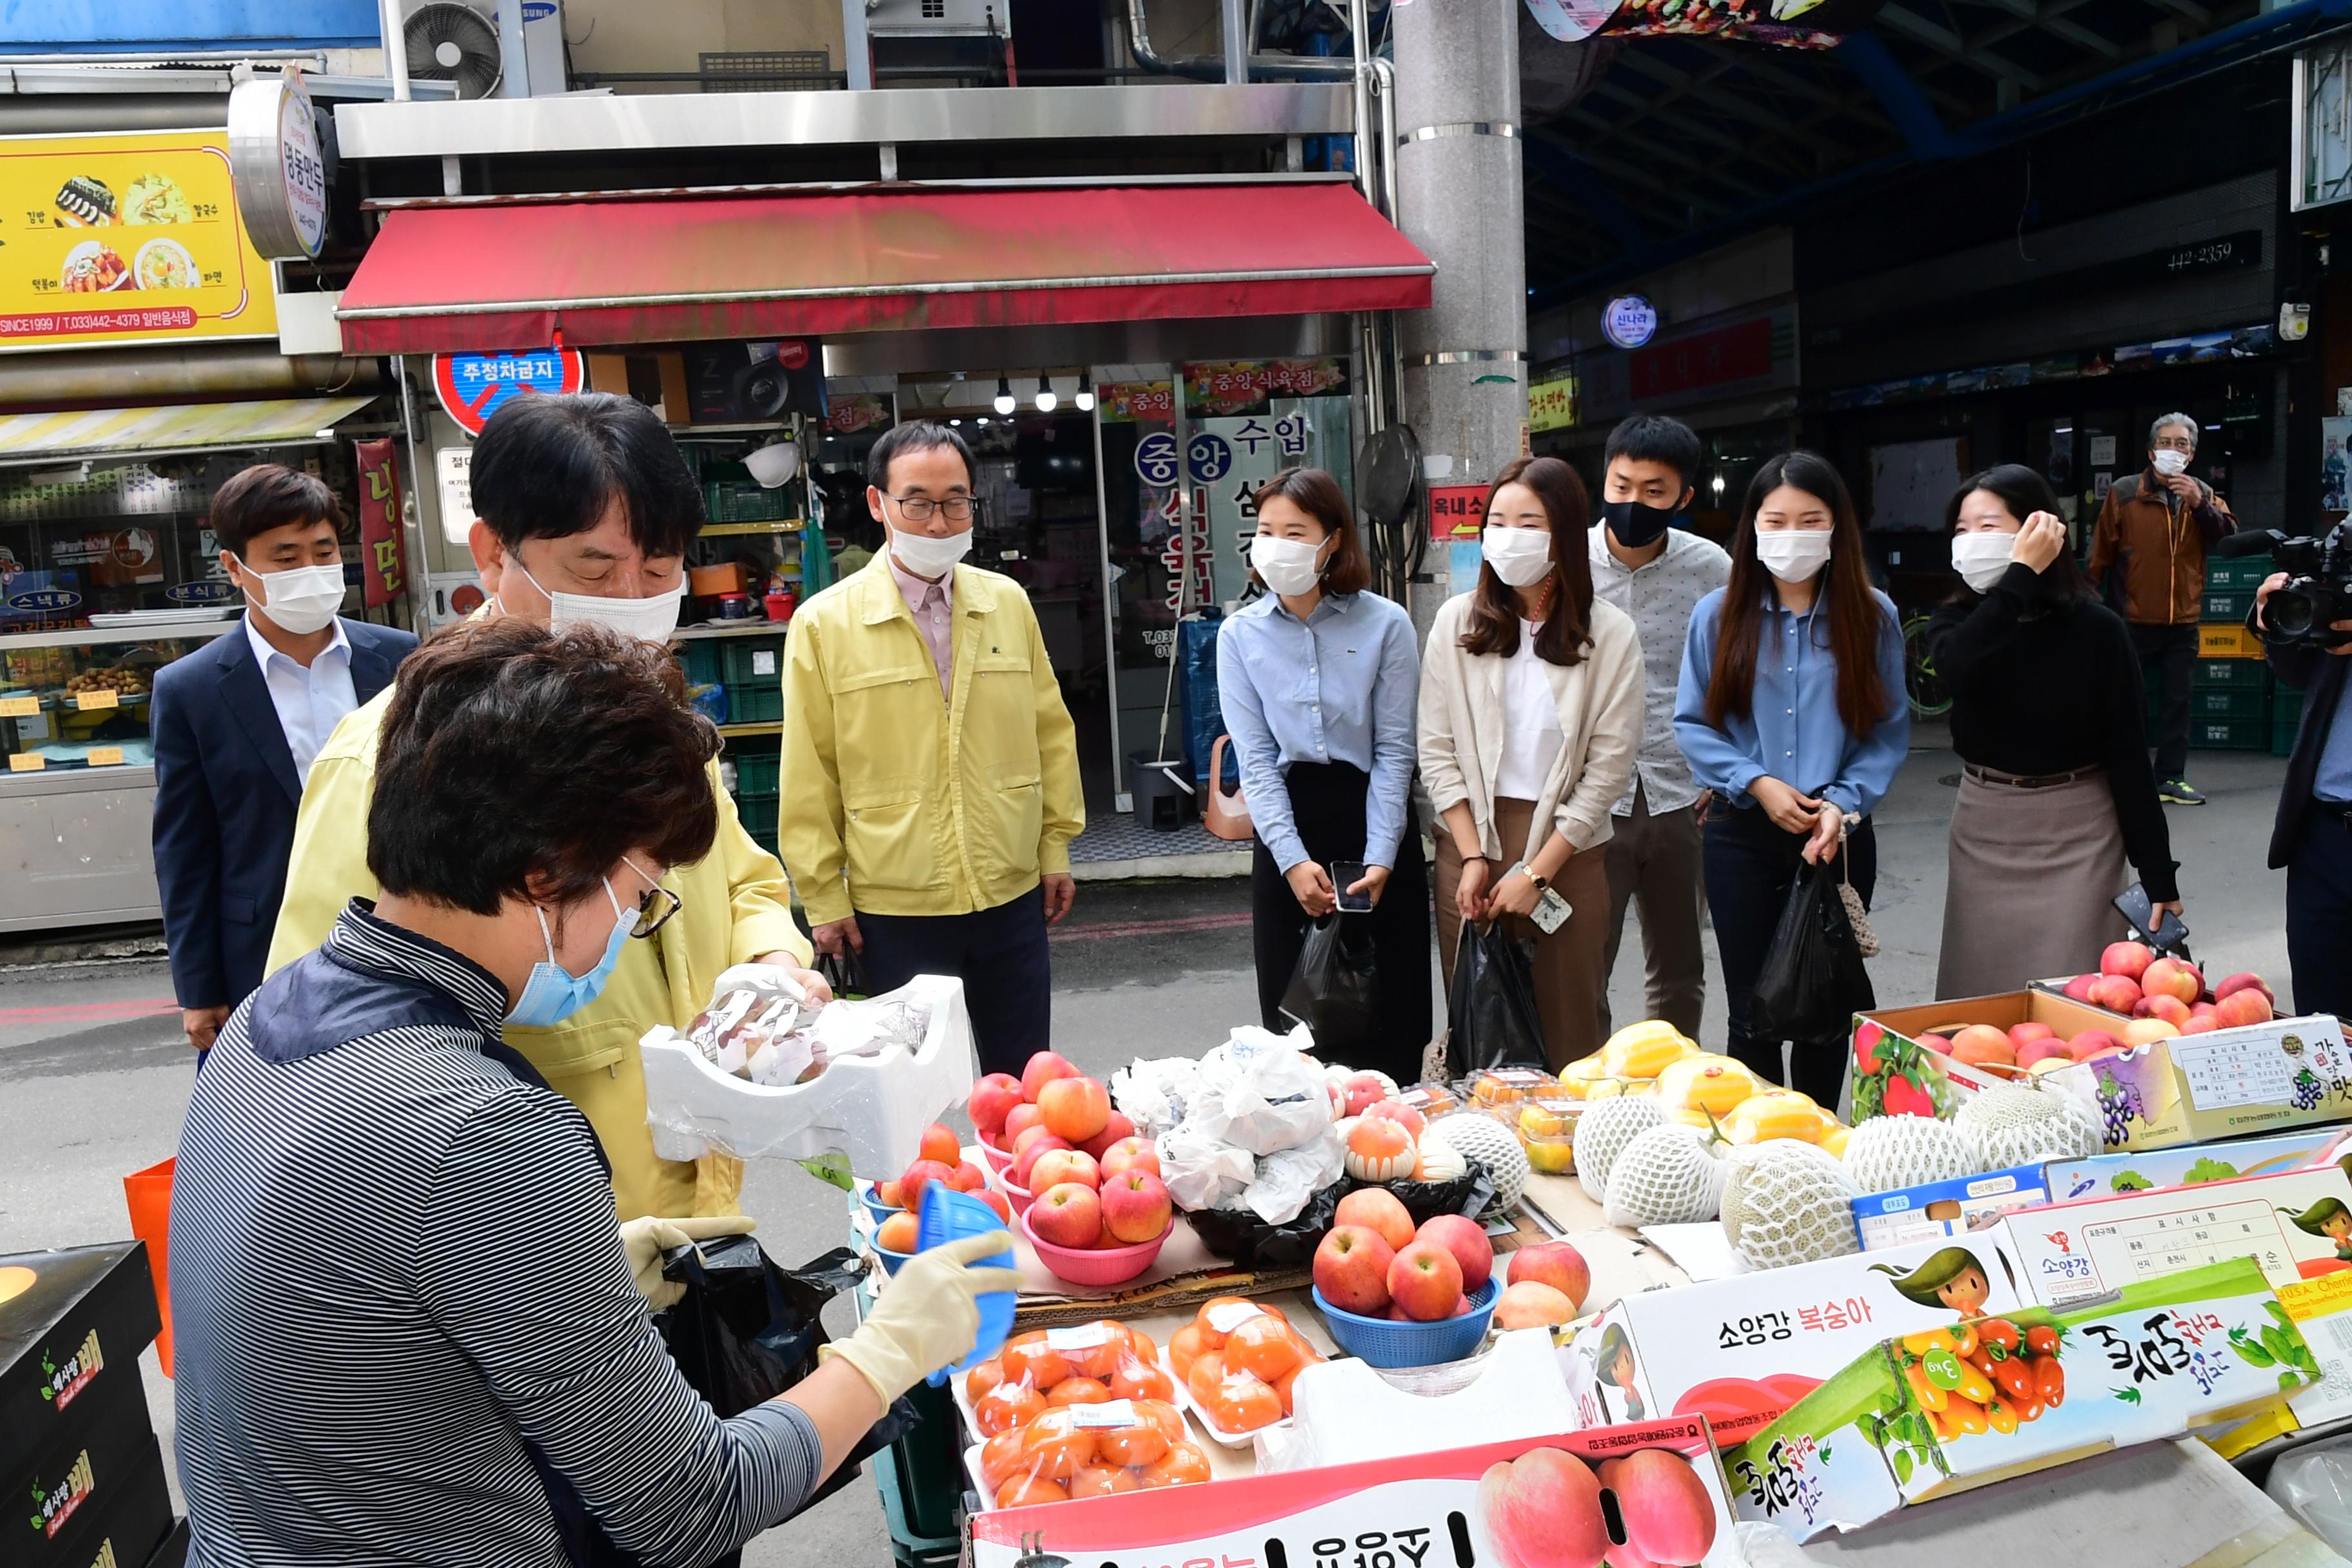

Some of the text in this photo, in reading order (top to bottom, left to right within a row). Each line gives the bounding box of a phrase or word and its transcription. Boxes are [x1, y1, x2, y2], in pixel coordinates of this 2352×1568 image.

[284, 141, 322, 197] 명동만두
[27, 210, 45, 224] 김밥
[193, 204, 218, 218] 칼국수
[32, 279, 57, 291] 떡볶이
[204, 271, 222, 284] 라면
[142, 309, 191, 326] 일반음식점
[1617, 314, 1647, 326] 신나라
[463, 360, 553, 382] 주정차금지
[1215, 369, 1314, 392] 중앙식육점
[1132, 391, 1172, 411] 중앙
[1233, 416, 1307, 456] 수입
[1141, 440, 1228, 480] 중앙
[364, 458, 402, 592] 냉면
[17, 594, 72, 607] 스낵류
[175, 584, 230, 599] 분식류
[2129, 1240, 2144, 1251] 품종
[2195, 1231, 2208, 1242] 등급
[2042, 1257, 2090, 1279] 소양강
[2136, 1259, 2151, 1269] 산지
[1718, 1295, 1872, 1349] 소양강 복숭아
[2082, 1311, 2193, 1384] 토마토
[1926, 1360, 1958, 1379] 3kg
[1588, 1426, 1686, 1451] 춘천원예농업협동조합
[1735, 1440, 1799, 1516] 토마토
